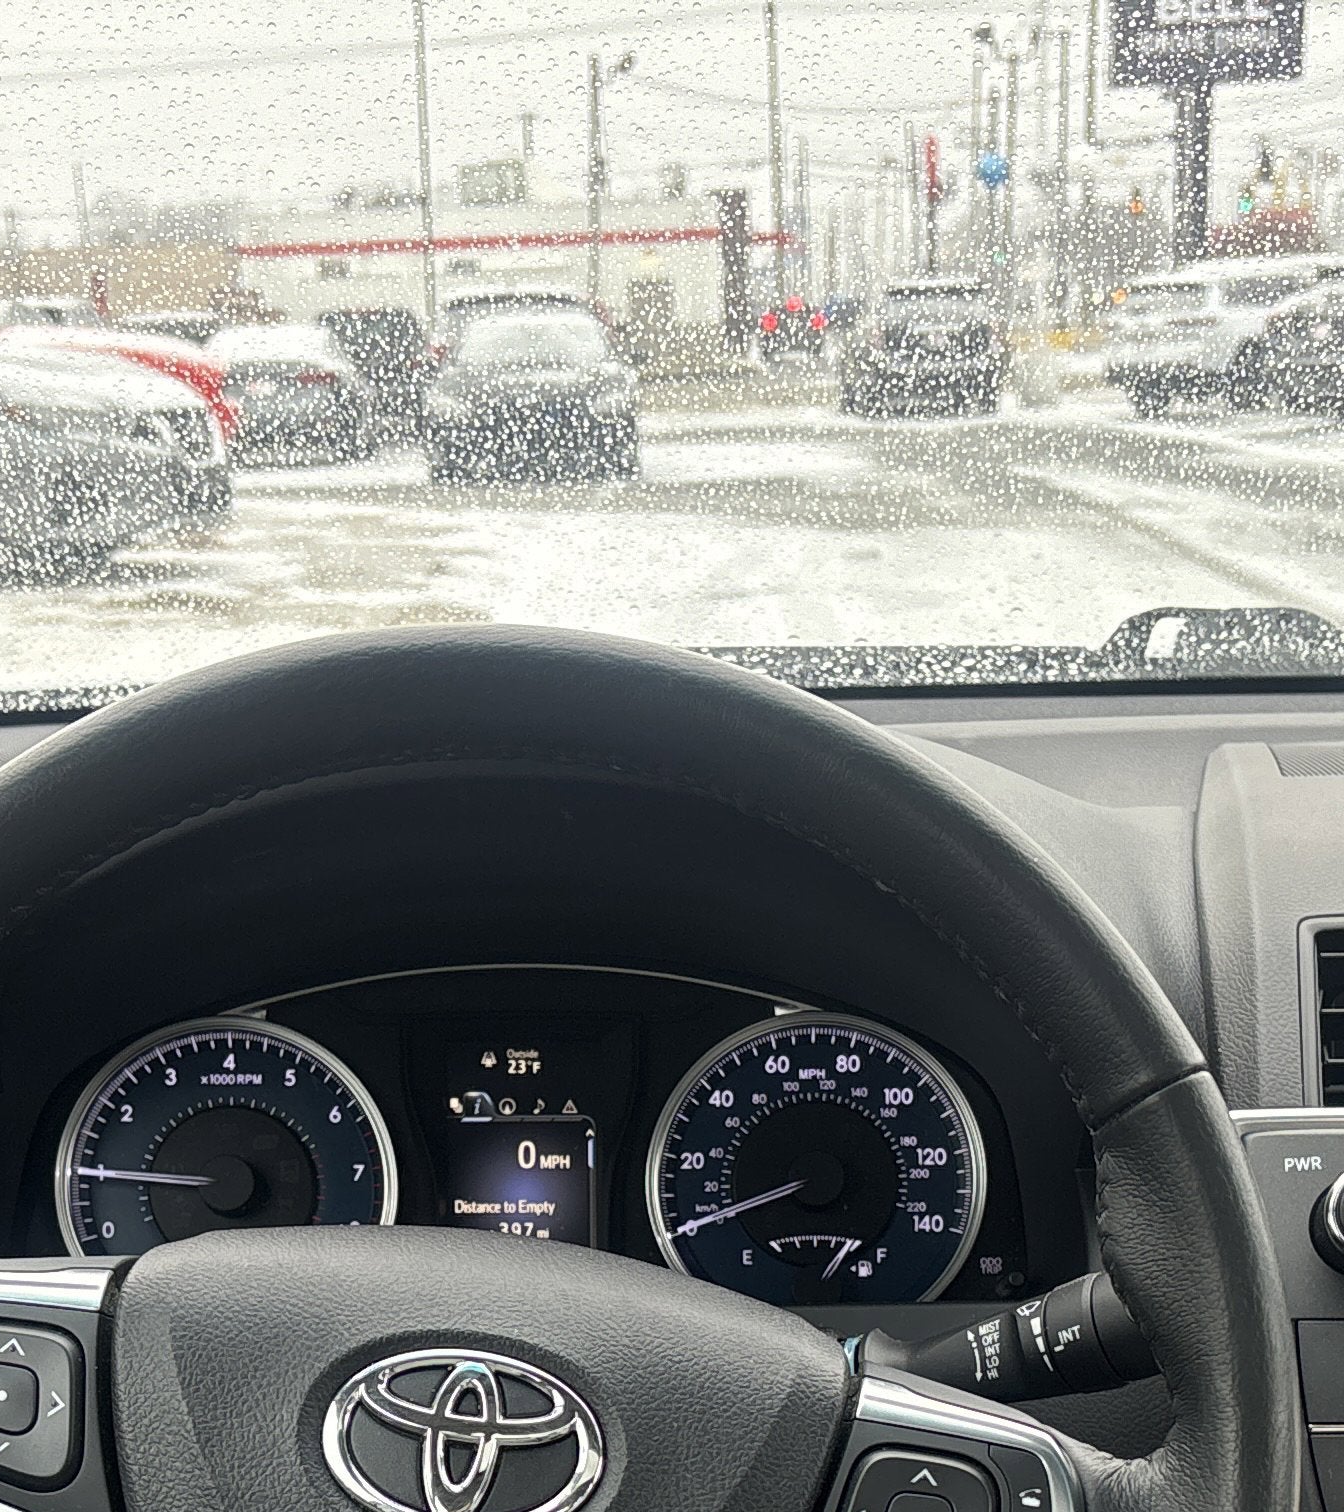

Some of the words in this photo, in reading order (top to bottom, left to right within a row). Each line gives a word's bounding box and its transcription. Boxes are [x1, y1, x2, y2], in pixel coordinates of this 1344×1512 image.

[223, 1053, 236, 1070] 4
[764, 1055, 790, 1074] 60
[835, 1054, 861, 1073] 80
[164, 1068, 178, 1086] 3
[236, 1074, 262, 1086] RPM
[284, 1069, 297, 1087] 5
[798, 1069, 826, 1080] MPH
[782, 1081, 800, 1092] 100
[819, 1080, 836, 1090] 120
[851, 1087, 868, 1098] 140
[708, 1090, 734, 1108] 40
[751, 1094, 768, 1105] 80
[883, 1088, 914, 1105] 100
[120, 1105, 134, 1123] 2
[329, 1105, 342, 1123] 6
[879, 1107, 898, 1118] 160
[724, 1117, 740, 1128] 60
[899, 1136, 918, 1147] 180
[518, 1140, 536, 1169] 0
[540, 1155, 571, 1170] MPH
[680, 1152, 705, 1170] 20
[708, 1148, 724, 1159] 40
[916, 1148, 947, 1166] 120
[1284, 1156, 1322, 1172] PWR
[352, 1164, 365, 1182] 7
[908, 1168, 930, 1179] 200
[703, 1181, 719, 1193] 20
[454, 1200, 501, 1214] Distance
[503, 1201, 516, 1214] to
[518, 1200, 555, 1216] Empty
[695, 1203, 719, 1213] km/h
[906, 1202, 927, 1213] 220
[102, 1221, 115, 1239] 0
[912, 1215, 944, 1233] 140
[536, 1228, 550, 1239] mi
[742, 1249, 753, 1265] E
[876, 1247, 888, 1264] F
[978, 1318, 1001, 1336] MIST
[1057, 1324, 1081, 1345] INT
[981, 1331, 1000, 1346] OFF
[984, 1343, 1001, 1358] INT
[986, 1355, 1000, 1369] LO
[986, 1367, 1000, 1380] HI
